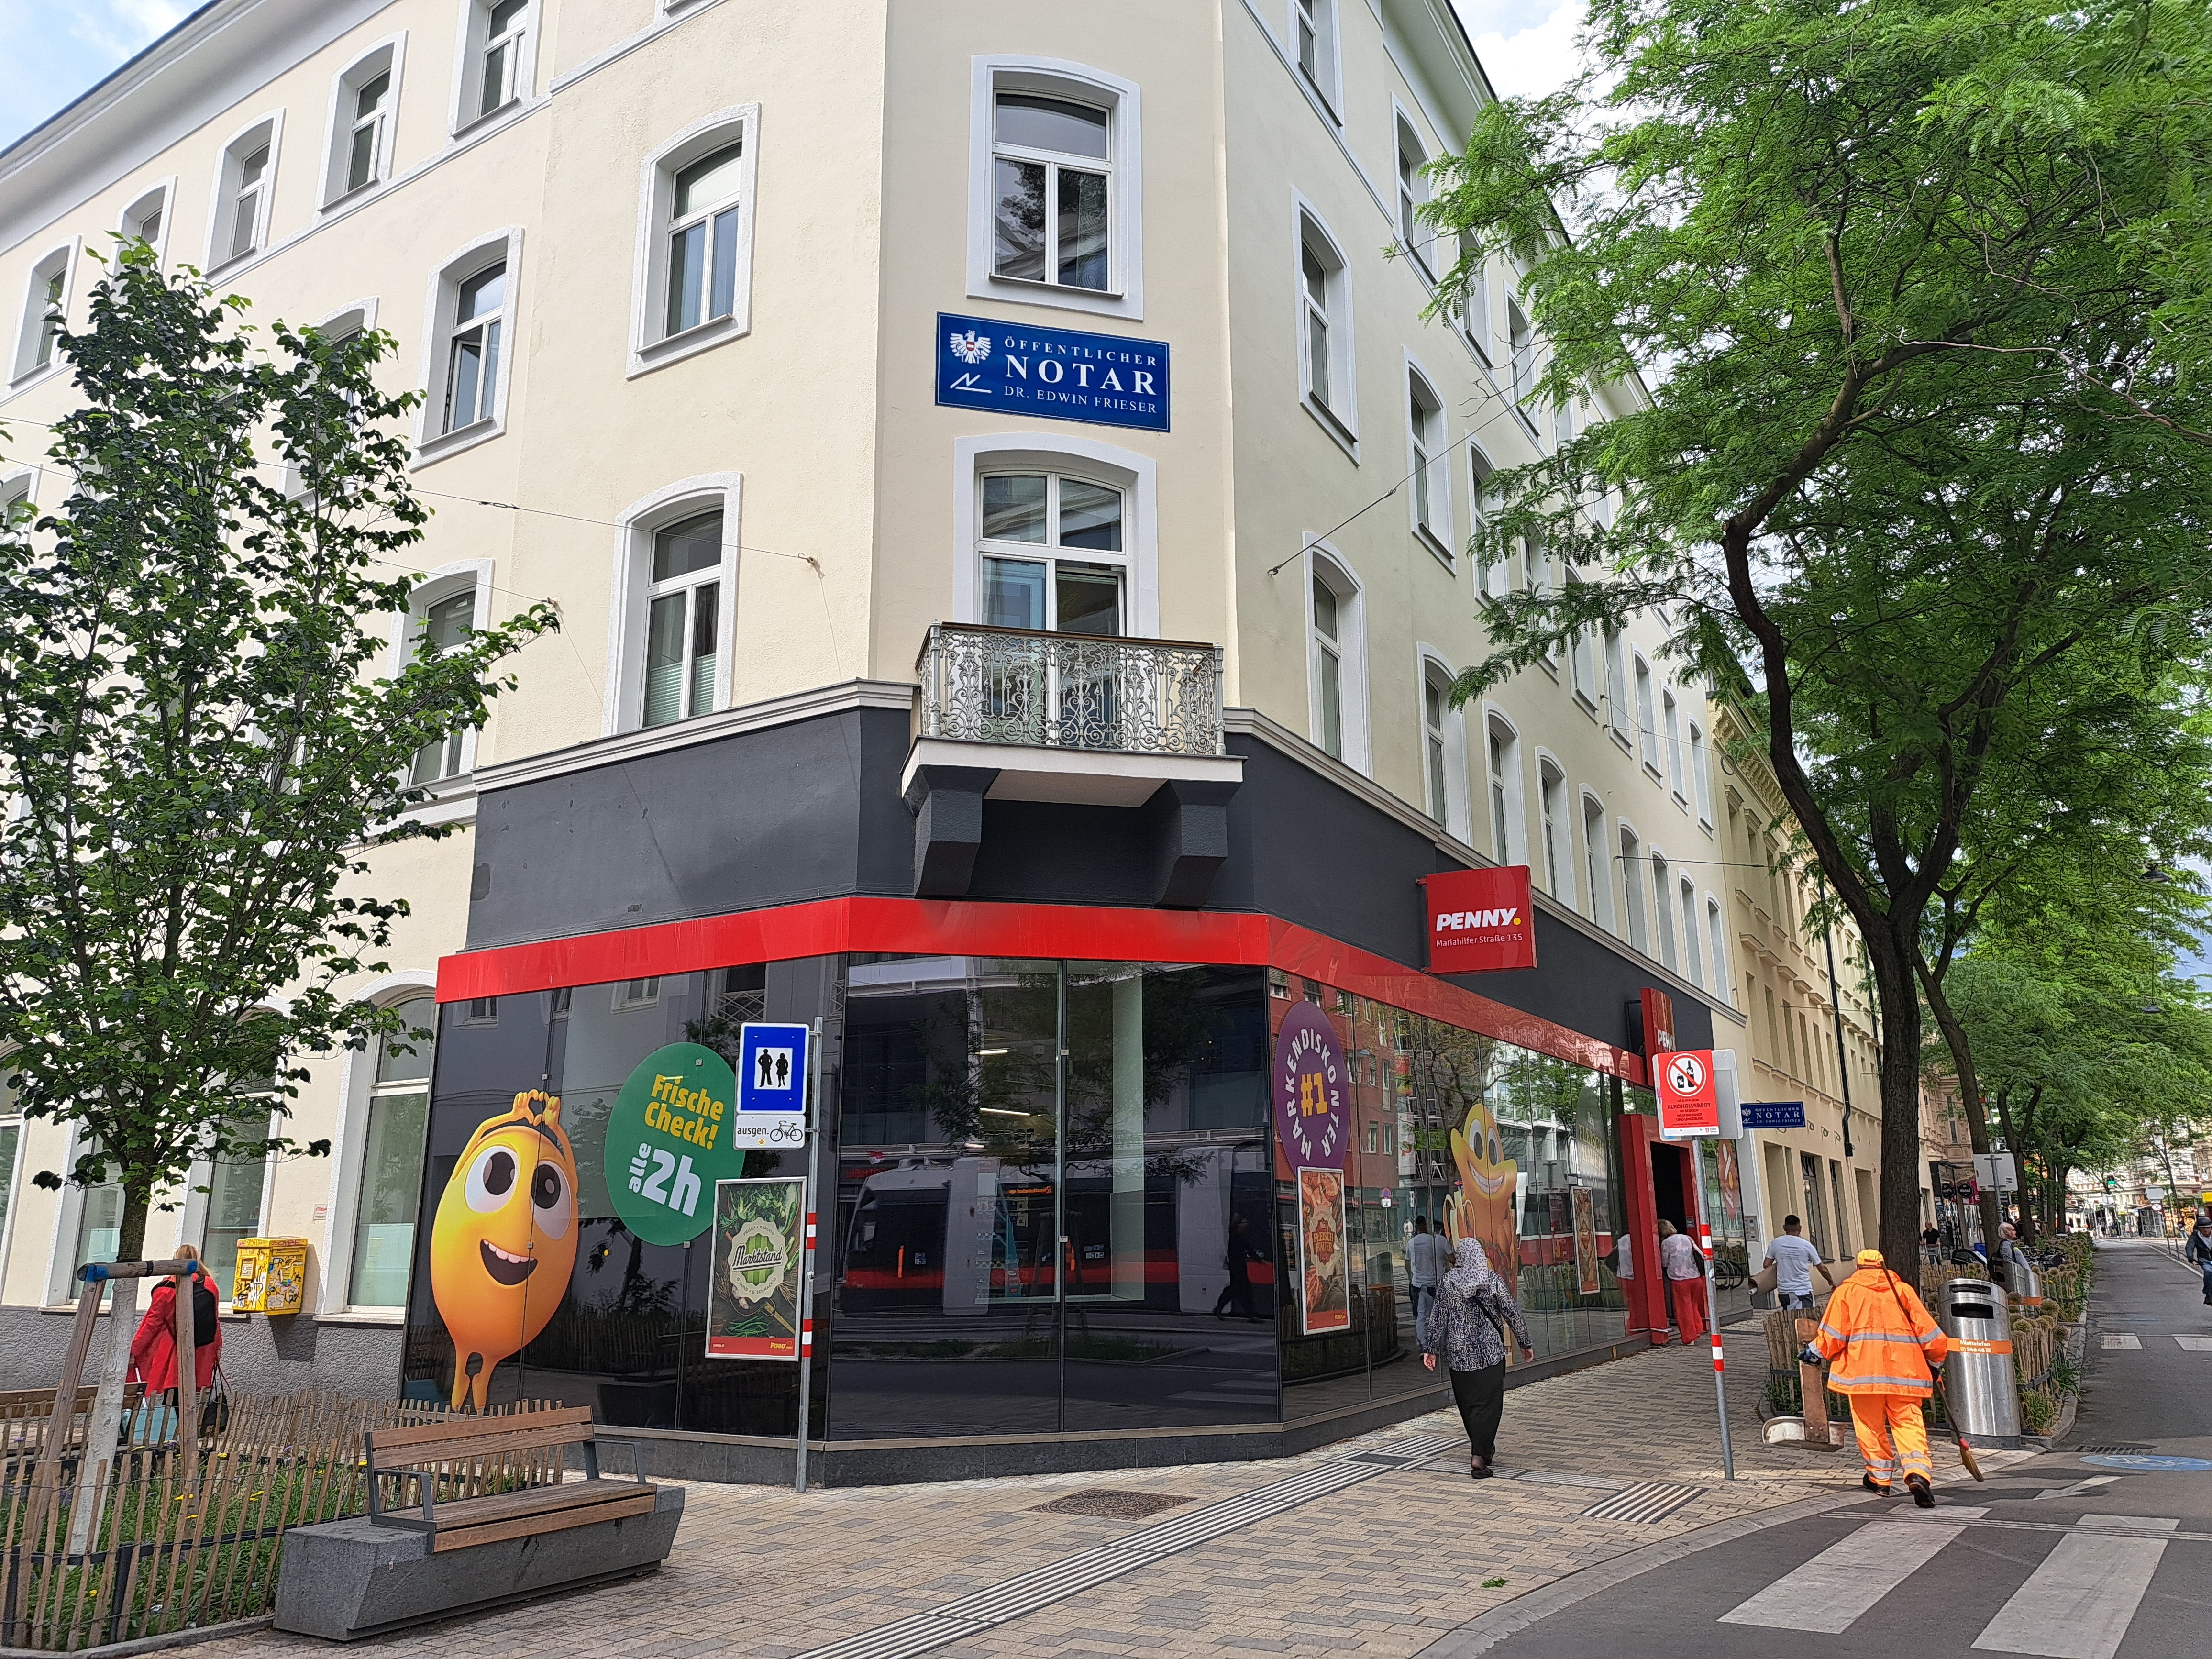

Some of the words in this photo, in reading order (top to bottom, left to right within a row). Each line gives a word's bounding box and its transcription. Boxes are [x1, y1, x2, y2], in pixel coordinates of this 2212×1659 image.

[1005, 336, 1156, 366] ÖFFENTLICHER
[1005, 354, 1157, 396] NOTAR
[1005, 386, 1030, 398] DR.
[1037, 389, 1087, 405] EDWIN
[1095, 397, 1157, 414] FRIESER
[1436, 936, 1478, 947] Mariahilfer
[1479, 934, 1505, 944] Straße
[1507, 933, 1523, 941] 135
[651, 1073, 724, 1121] Frische
[1300, 1072, 1328, 1117] #1
[644, 1101, 719, 1150] Check!
[1756, 1111, 1801, 1119] NOTAR
[737, 1127, 769, 1137] ausgen.
[1579, 1123, 1604, 1159] FLEISCH
[628, 1142, 652, 1193] alle
[1582, 1143, 1603, 1174] HAUER
[641, 1149, 701, 1217] 2h
[743, 1226, 756, 1236] FRISCH
[759, 1225, 775, 1236] KNACKIG
[1313, 1232, 1334, 1243] FLEISCH
[731, 1245, 783, 1267] Marktstand
[1316, 1241, 1333, 1252] HAUER
[737, 1277, 749, 1292] G'SUND
[752, 1277, 777, 1294] G'SCHMACKIG
